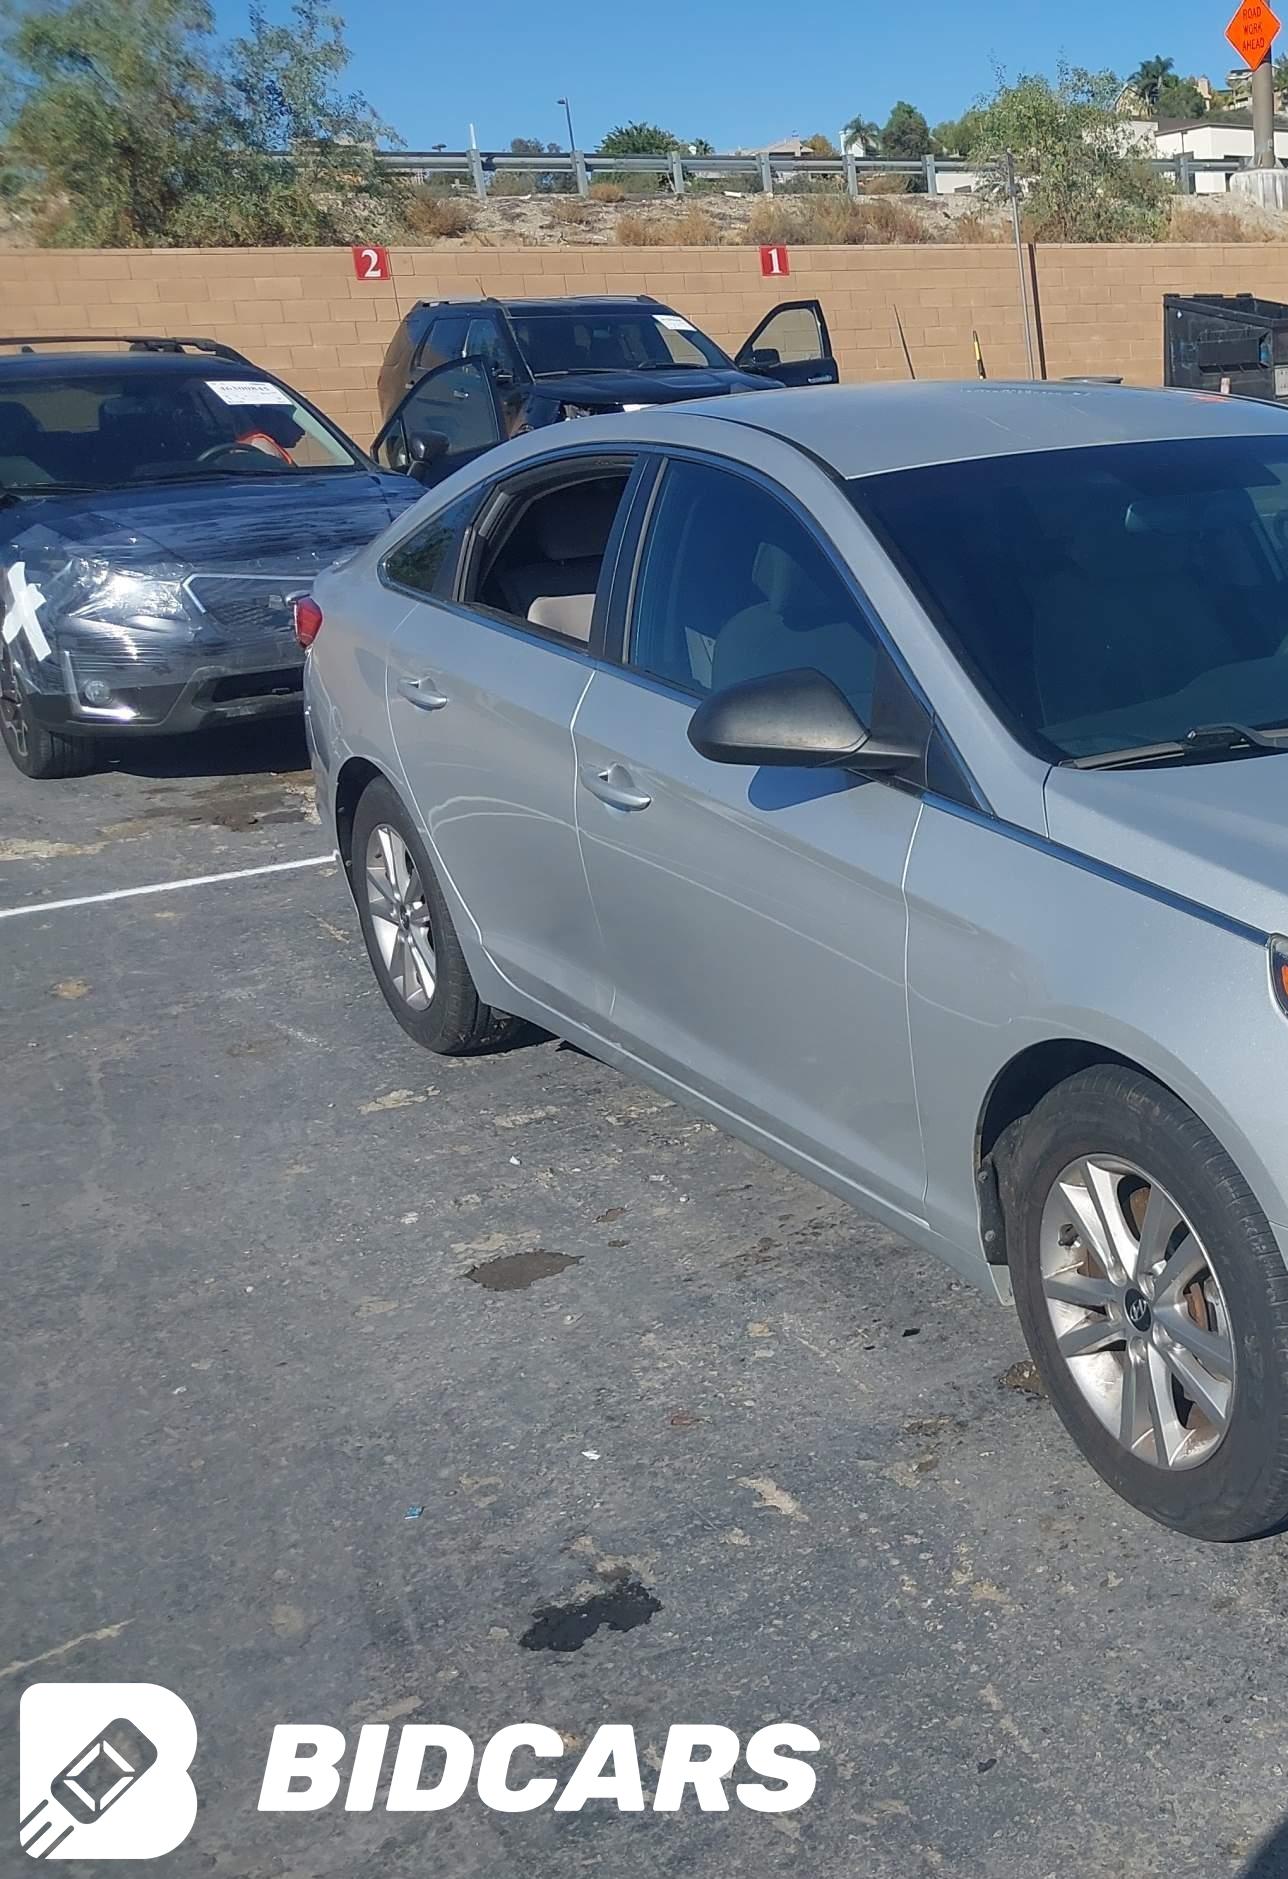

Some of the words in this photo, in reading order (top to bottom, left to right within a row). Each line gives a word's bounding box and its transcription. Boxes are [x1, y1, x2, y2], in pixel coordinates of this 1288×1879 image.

[1242, 7, 1261, 20] ROAD
[1243, 22, 1263, 35] WORK
[1242, 37, 1265, 52] AHEAD
[361, 249, 381, 277] 2
[767, 248, 782, 274] 1
